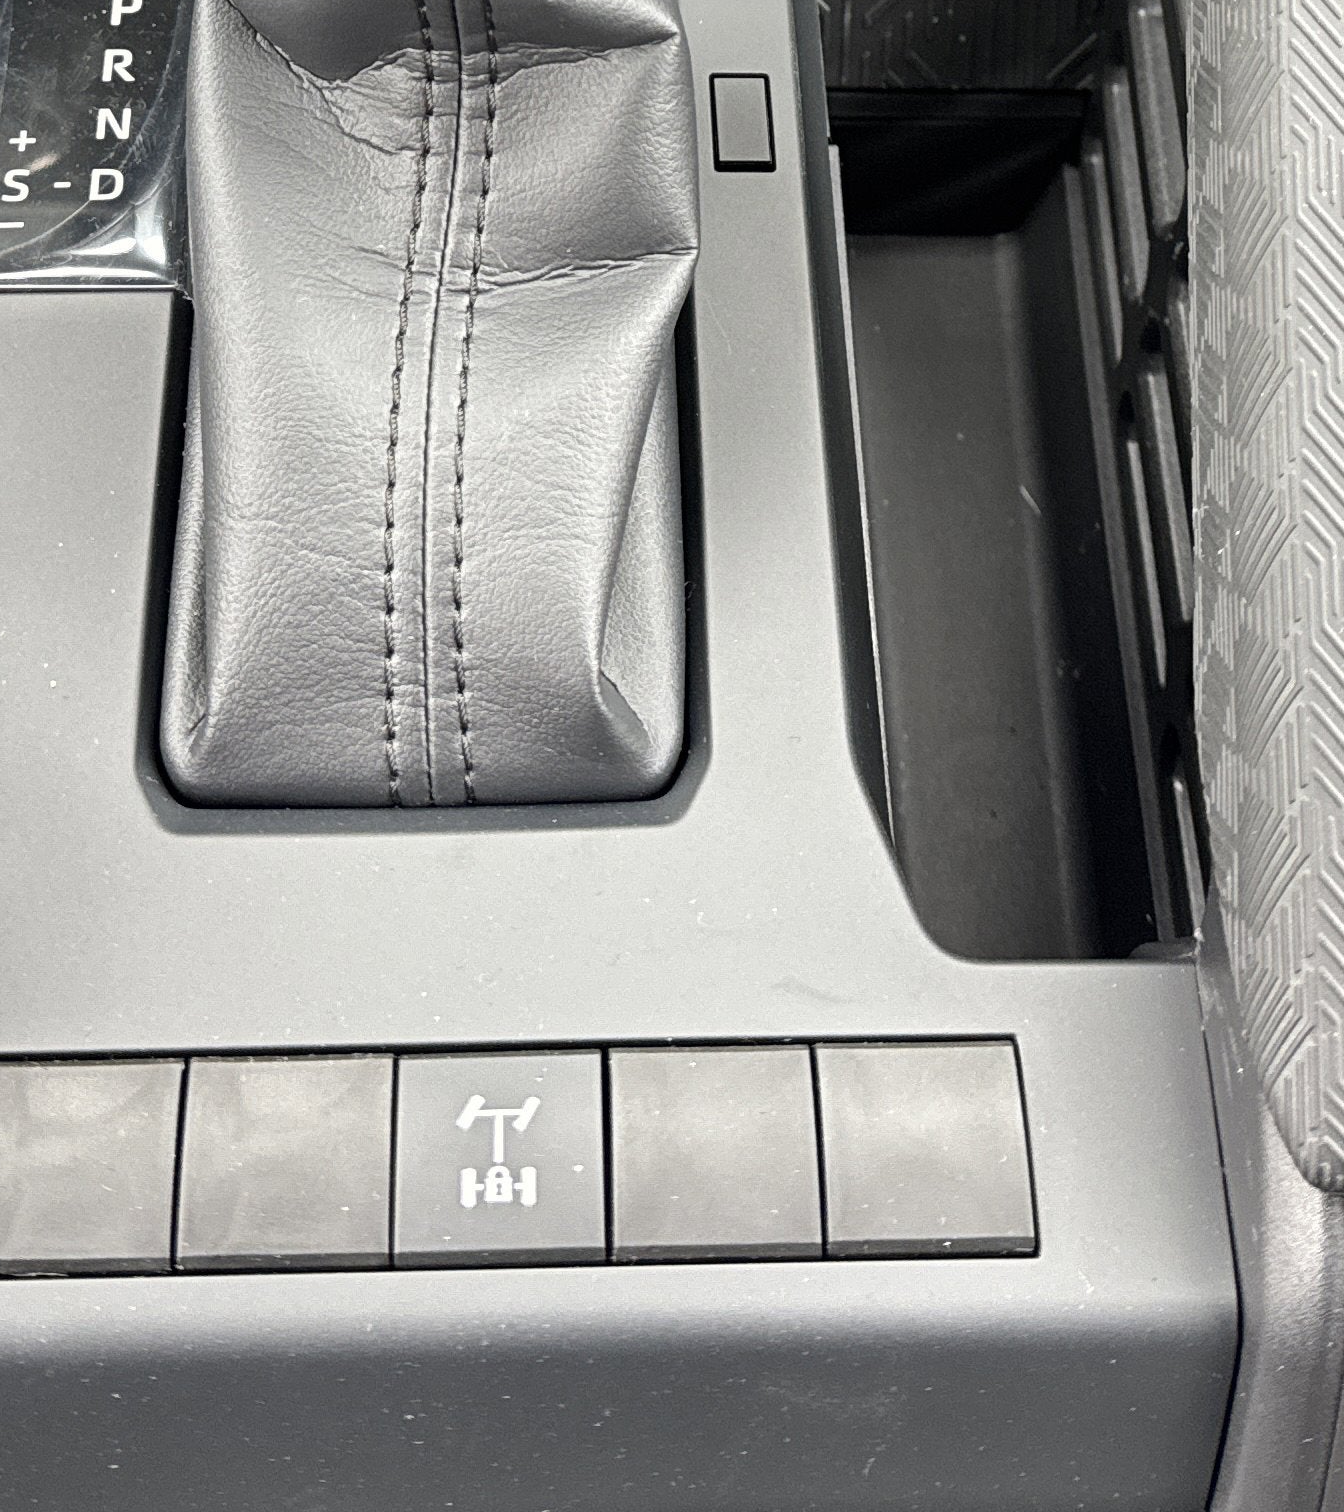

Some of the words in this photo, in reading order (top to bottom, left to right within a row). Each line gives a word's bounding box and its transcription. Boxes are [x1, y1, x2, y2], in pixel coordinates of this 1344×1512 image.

[101, 48, 136, 83] R
[95, 107, 132, 140] N
[88, 168, 124, 202] D
